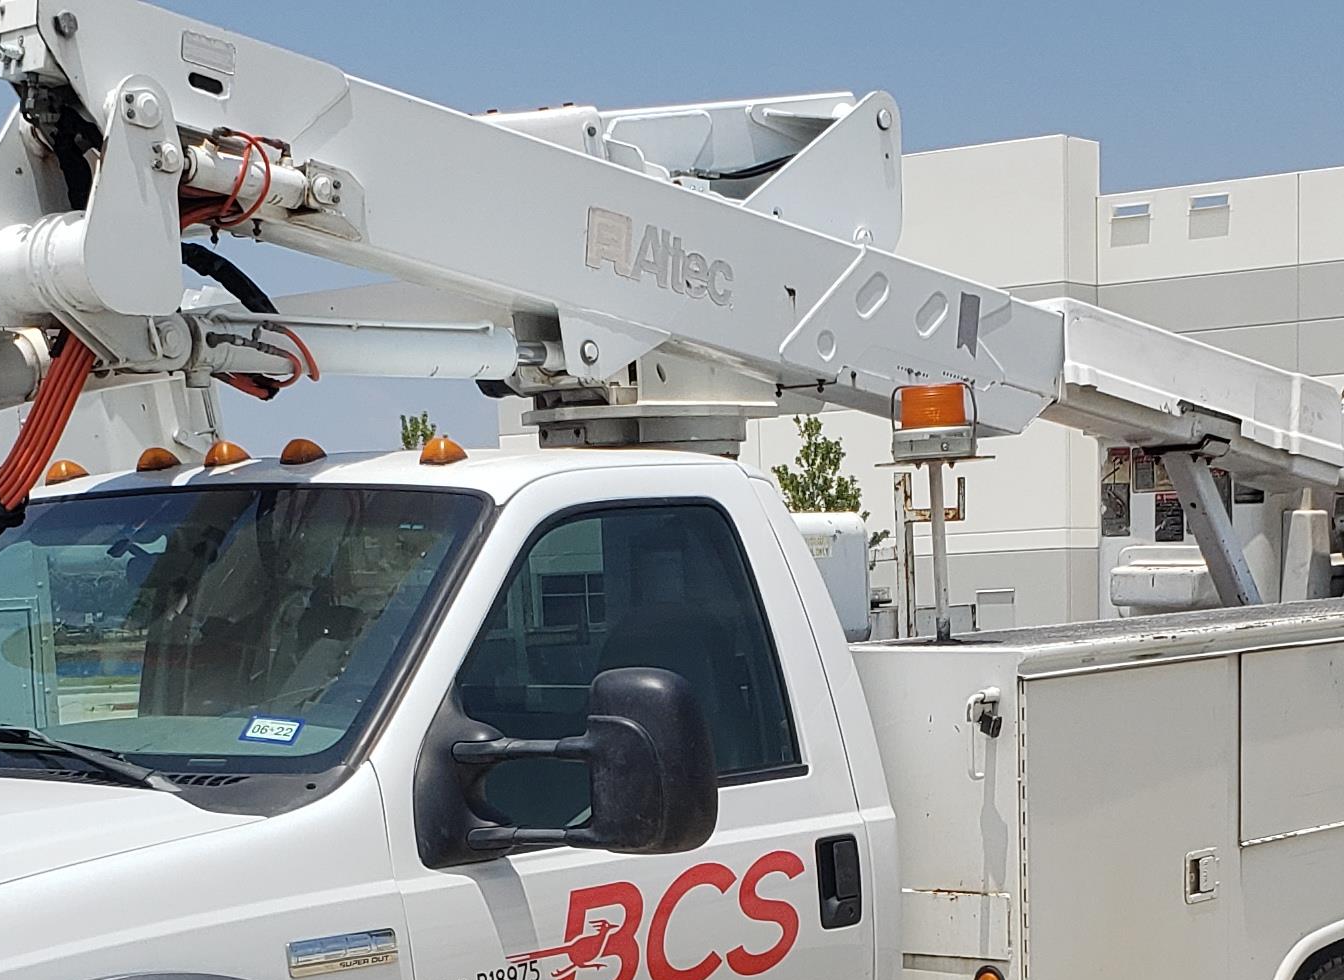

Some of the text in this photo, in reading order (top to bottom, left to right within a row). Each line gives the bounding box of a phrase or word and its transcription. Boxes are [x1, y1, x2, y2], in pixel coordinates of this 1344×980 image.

[630, 223, 733, 306] Altec
[339, 954, 397, 968] SUPER DUT
